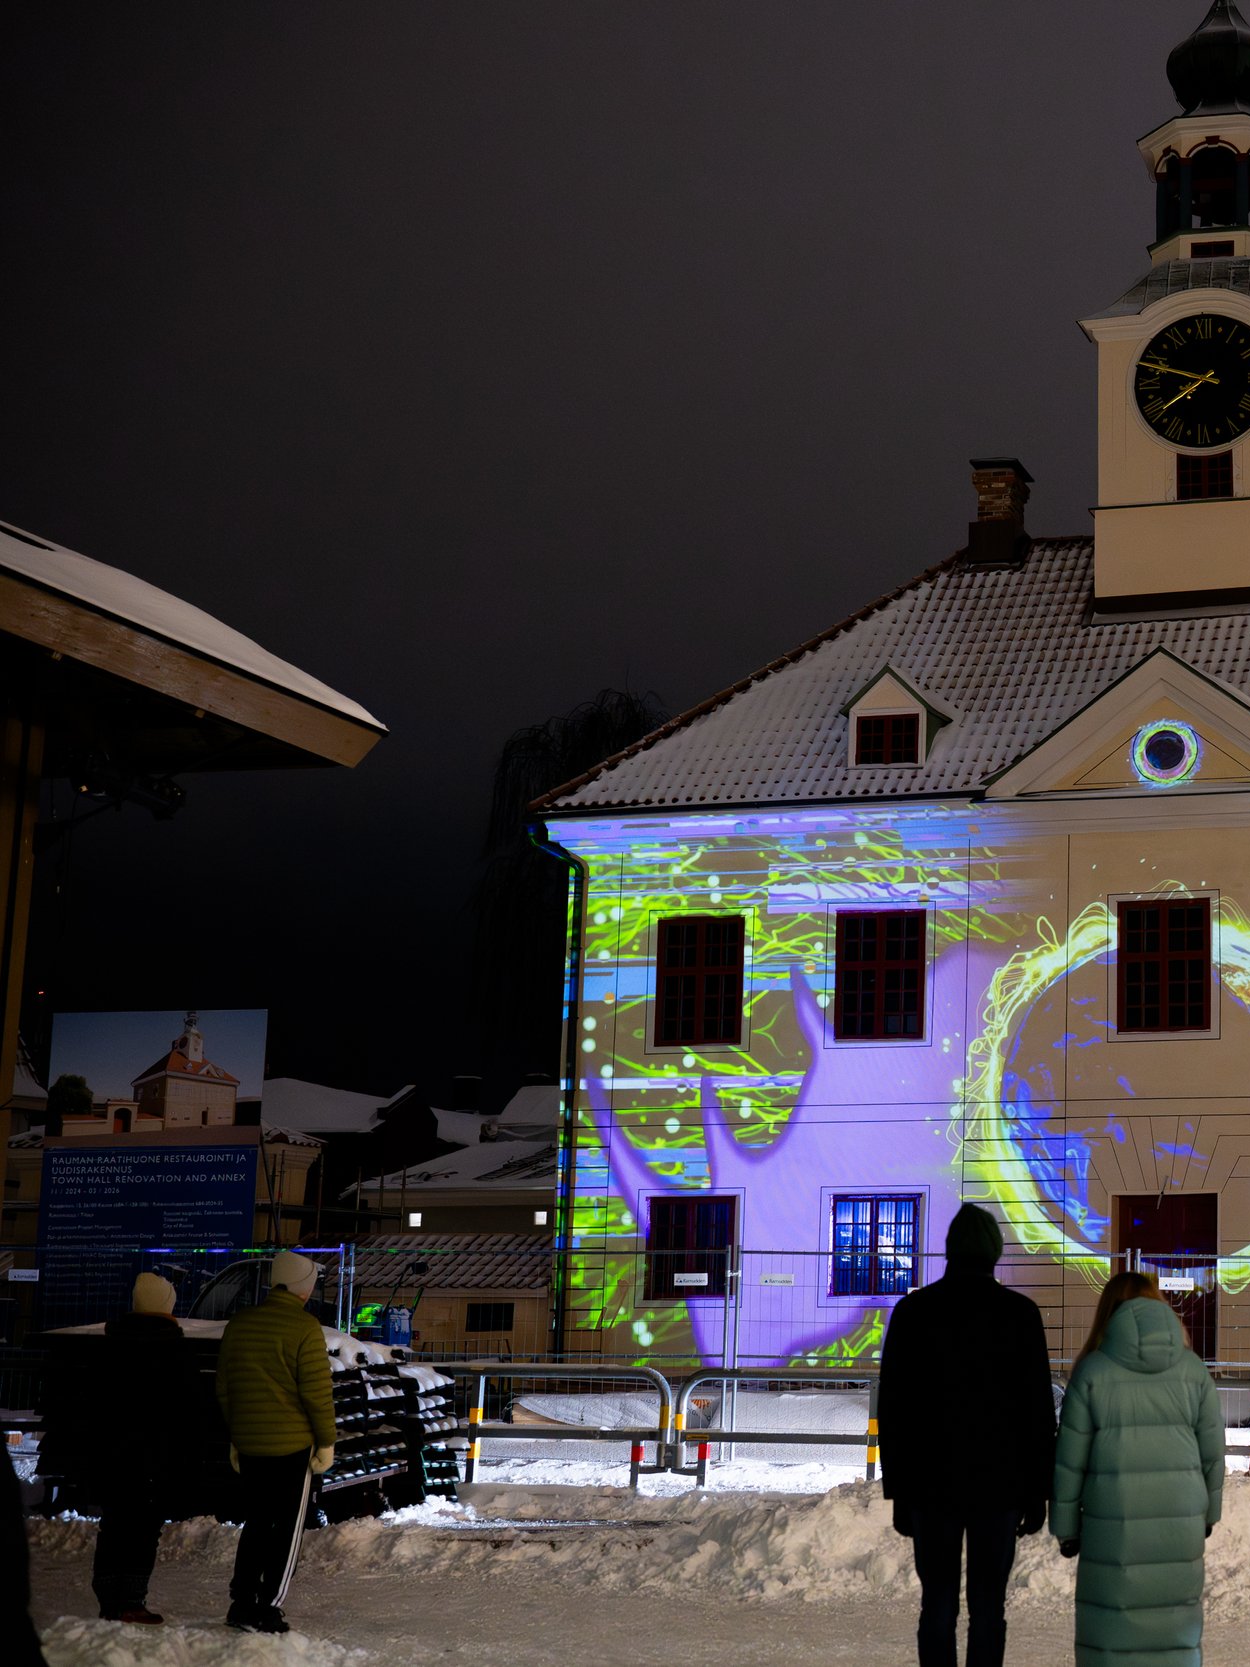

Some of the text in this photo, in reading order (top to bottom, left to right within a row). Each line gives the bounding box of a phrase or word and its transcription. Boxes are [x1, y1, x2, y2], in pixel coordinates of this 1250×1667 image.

[1195, 318, 1212, 339] XII
[51, 1153, 247, 1166] RAUMAN RAATIHUONE RESTAUROINTI JA
[51, 1165, 133, 1175] UUDISRAKENNUS
[51, 1173, 247, 1185] TOWN HALL RENOVATION AND ANNEX
[64, 1187, 82, 1196] 2024
[103, 1187, 120, 1195] 2026
